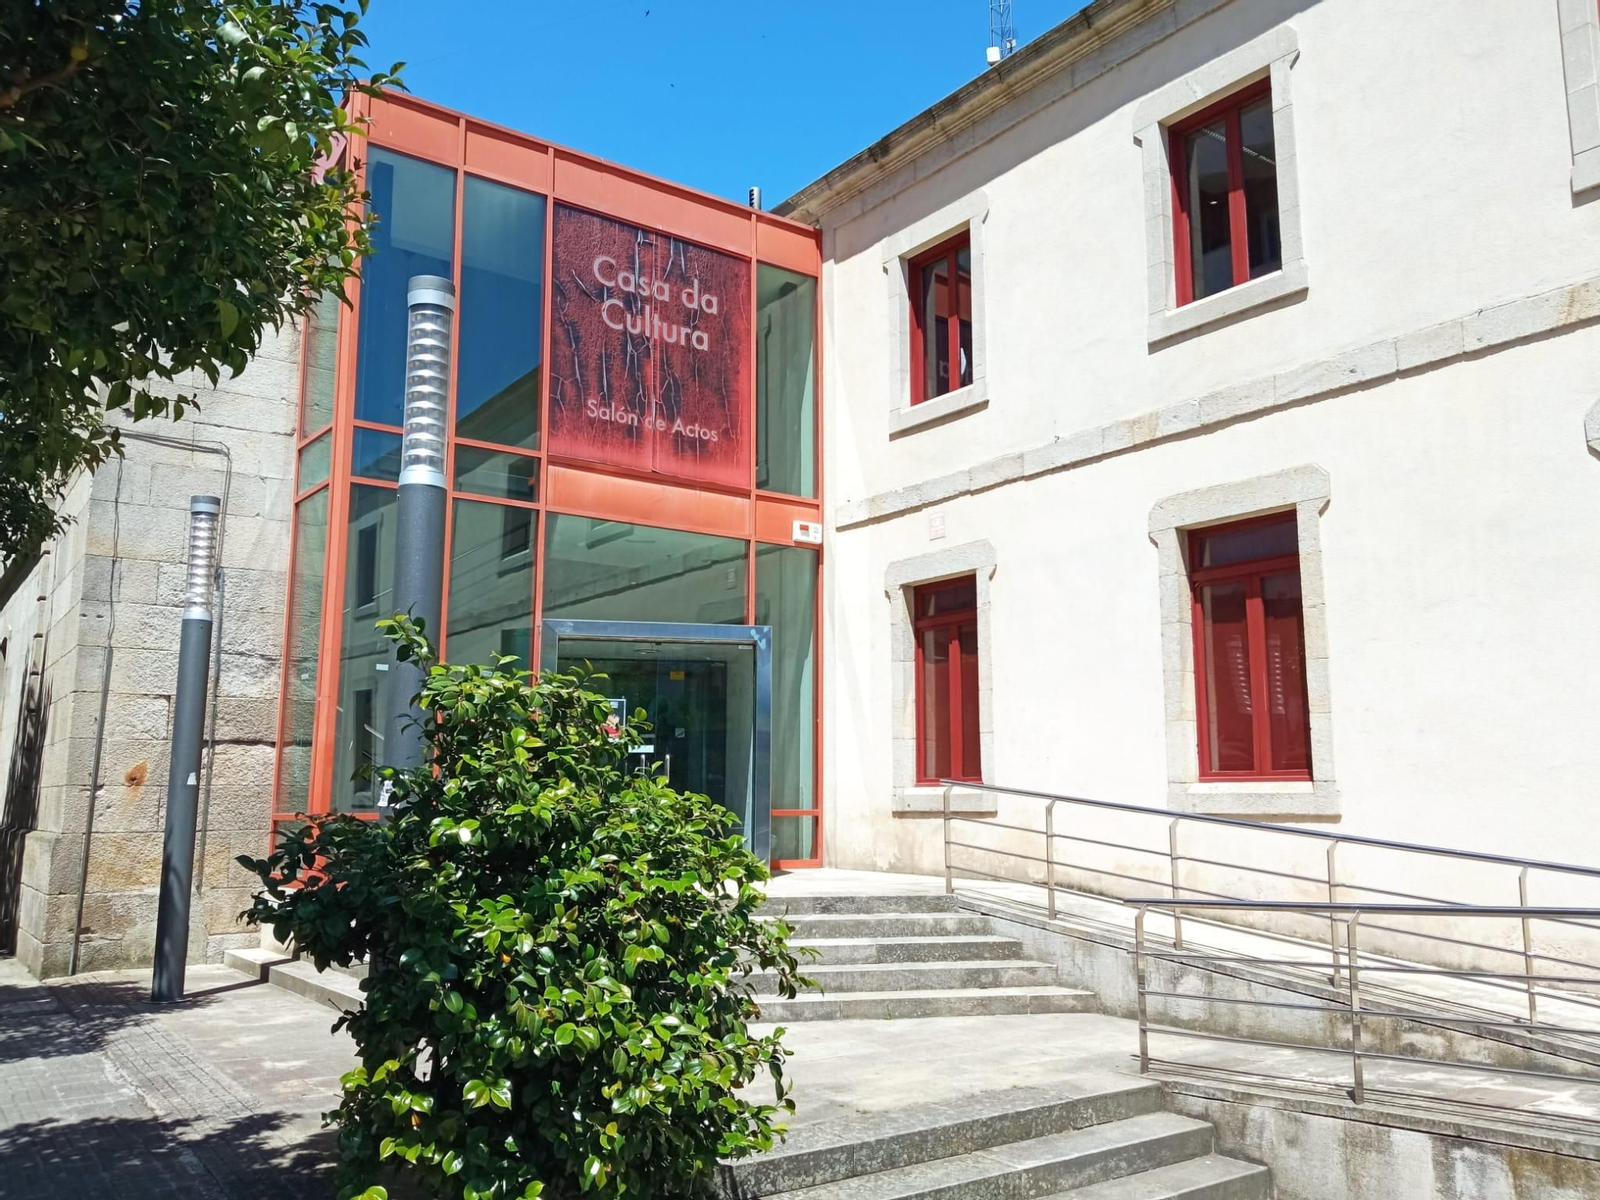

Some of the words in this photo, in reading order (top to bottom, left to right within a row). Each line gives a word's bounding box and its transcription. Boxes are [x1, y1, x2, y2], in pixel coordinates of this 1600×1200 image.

[593, 255, 670, 302] Casa
[681, 278, 718, 315] da
[601, 299, 709, 351] Cultura
[586, 399, 638, 426] Salón
[644, 410, 666, 431] de
[671, 416, 719, 442] Actos
